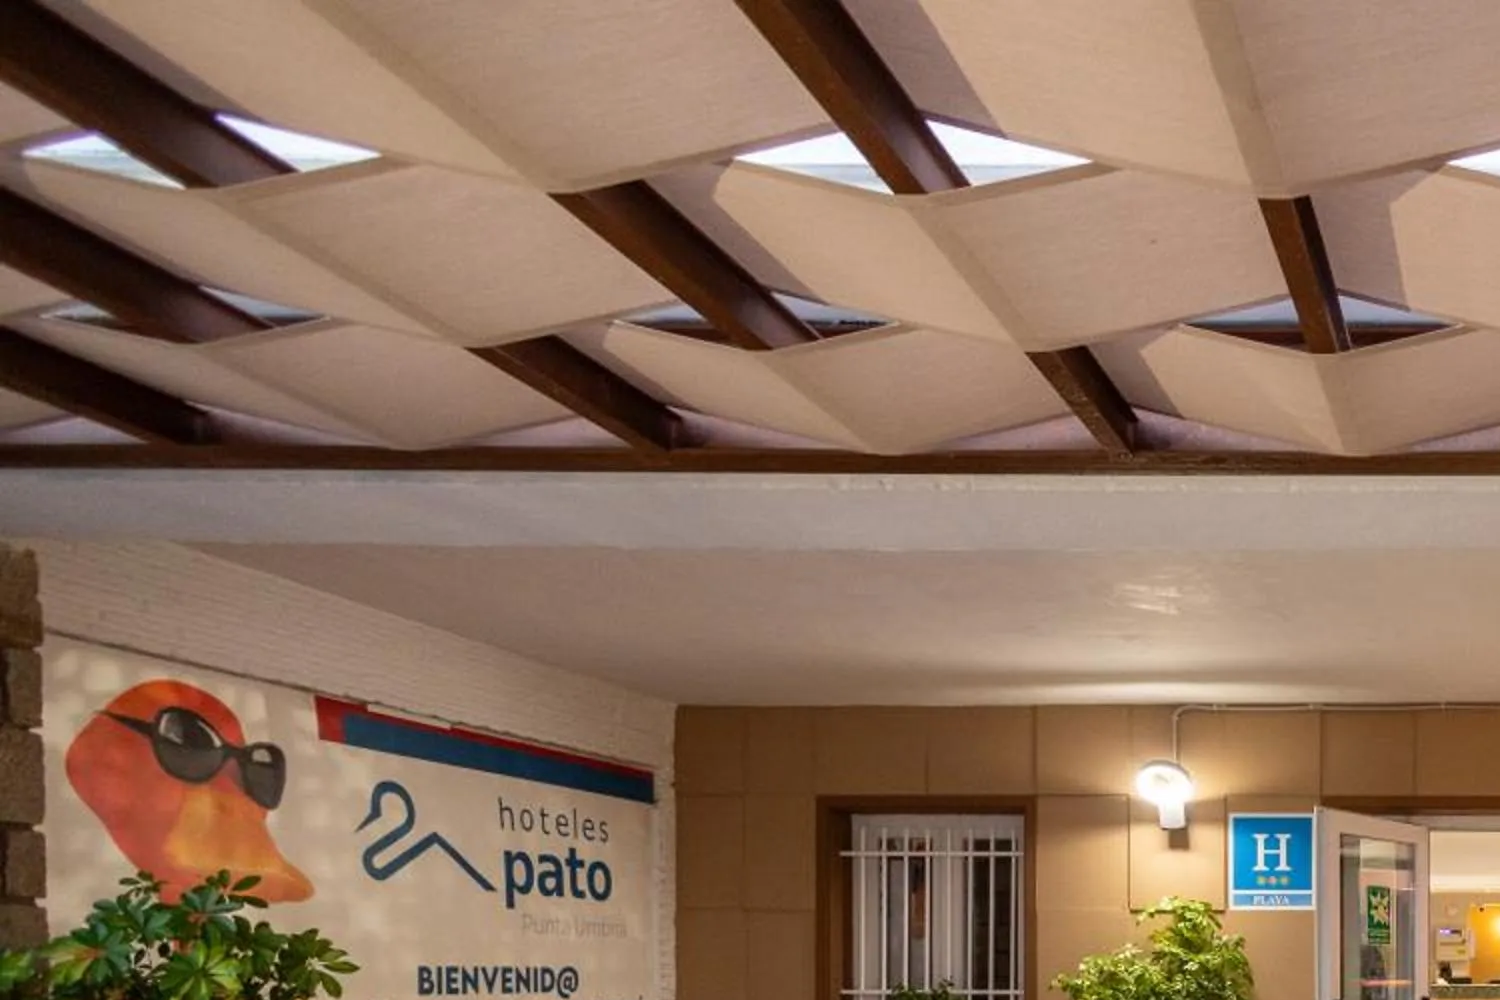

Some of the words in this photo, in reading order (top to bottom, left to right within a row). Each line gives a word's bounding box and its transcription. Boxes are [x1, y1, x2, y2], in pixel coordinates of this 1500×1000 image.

[498, 797, 609, 843] hoteles
[1252, 833, 1292, 871] H
[504, 848, 612, 909] pato
[1253, 895, 1289, 905] PLAYA
[417, 965, 579, 997] BIENVENID@
